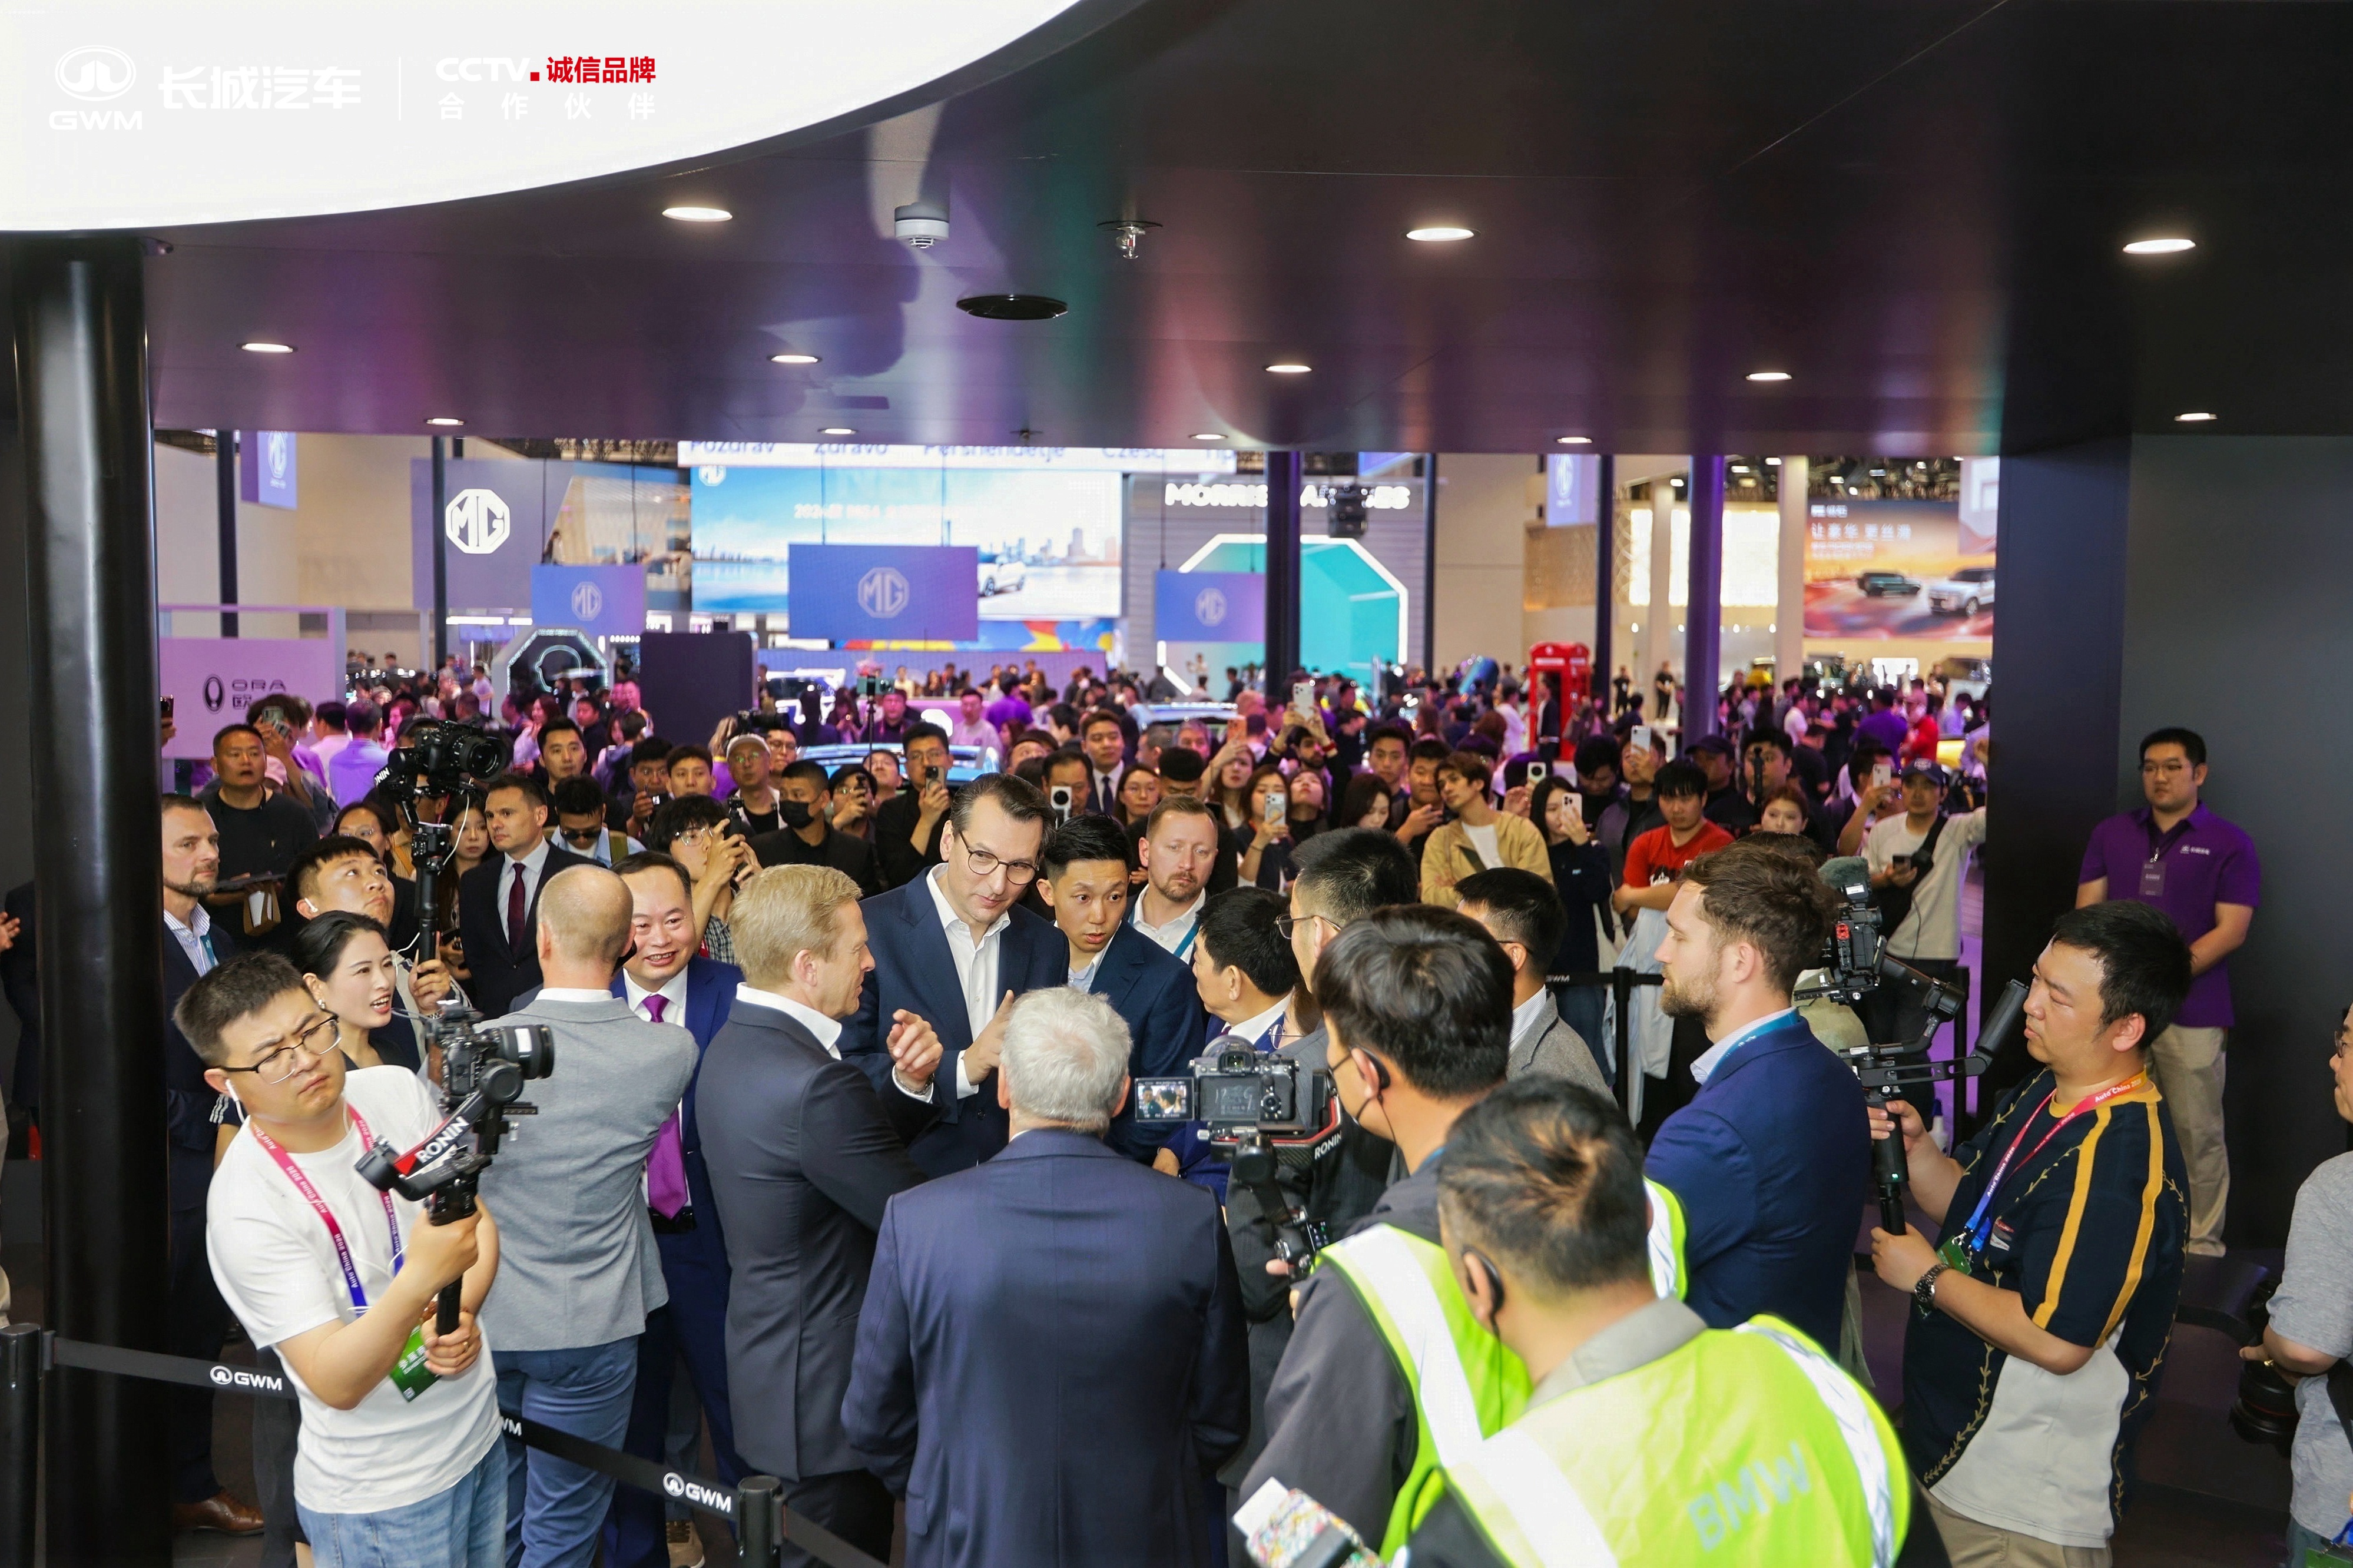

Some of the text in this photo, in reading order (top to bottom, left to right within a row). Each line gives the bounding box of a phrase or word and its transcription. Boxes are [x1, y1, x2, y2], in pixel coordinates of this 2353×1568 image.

[449, 494, 506, 549] MG
[574, 584, 601, 619] MG
[861, 570, 906, 615] MG
[232, 679, 286, 692] ORA
[2094, 1091, 2112, 1103] Auto
[2112, 1083, 2131, 1094] China
[415, 1116, 470, 1163] RONIN
[1314, 1131, 1342, 1160] RONIN
[299, 1180, 317, 1199] China
[1987, 1181, 1997, 1198] Auto
[1994, 1162, 2006, 1181] China
[333, 1233, 359, 1288] Auto China 2026
[234, 1371, 283, 1391] GWM
[685, 1482, 732, 1513] GWM
[1688, 1440, 1811, 1553] BMW
